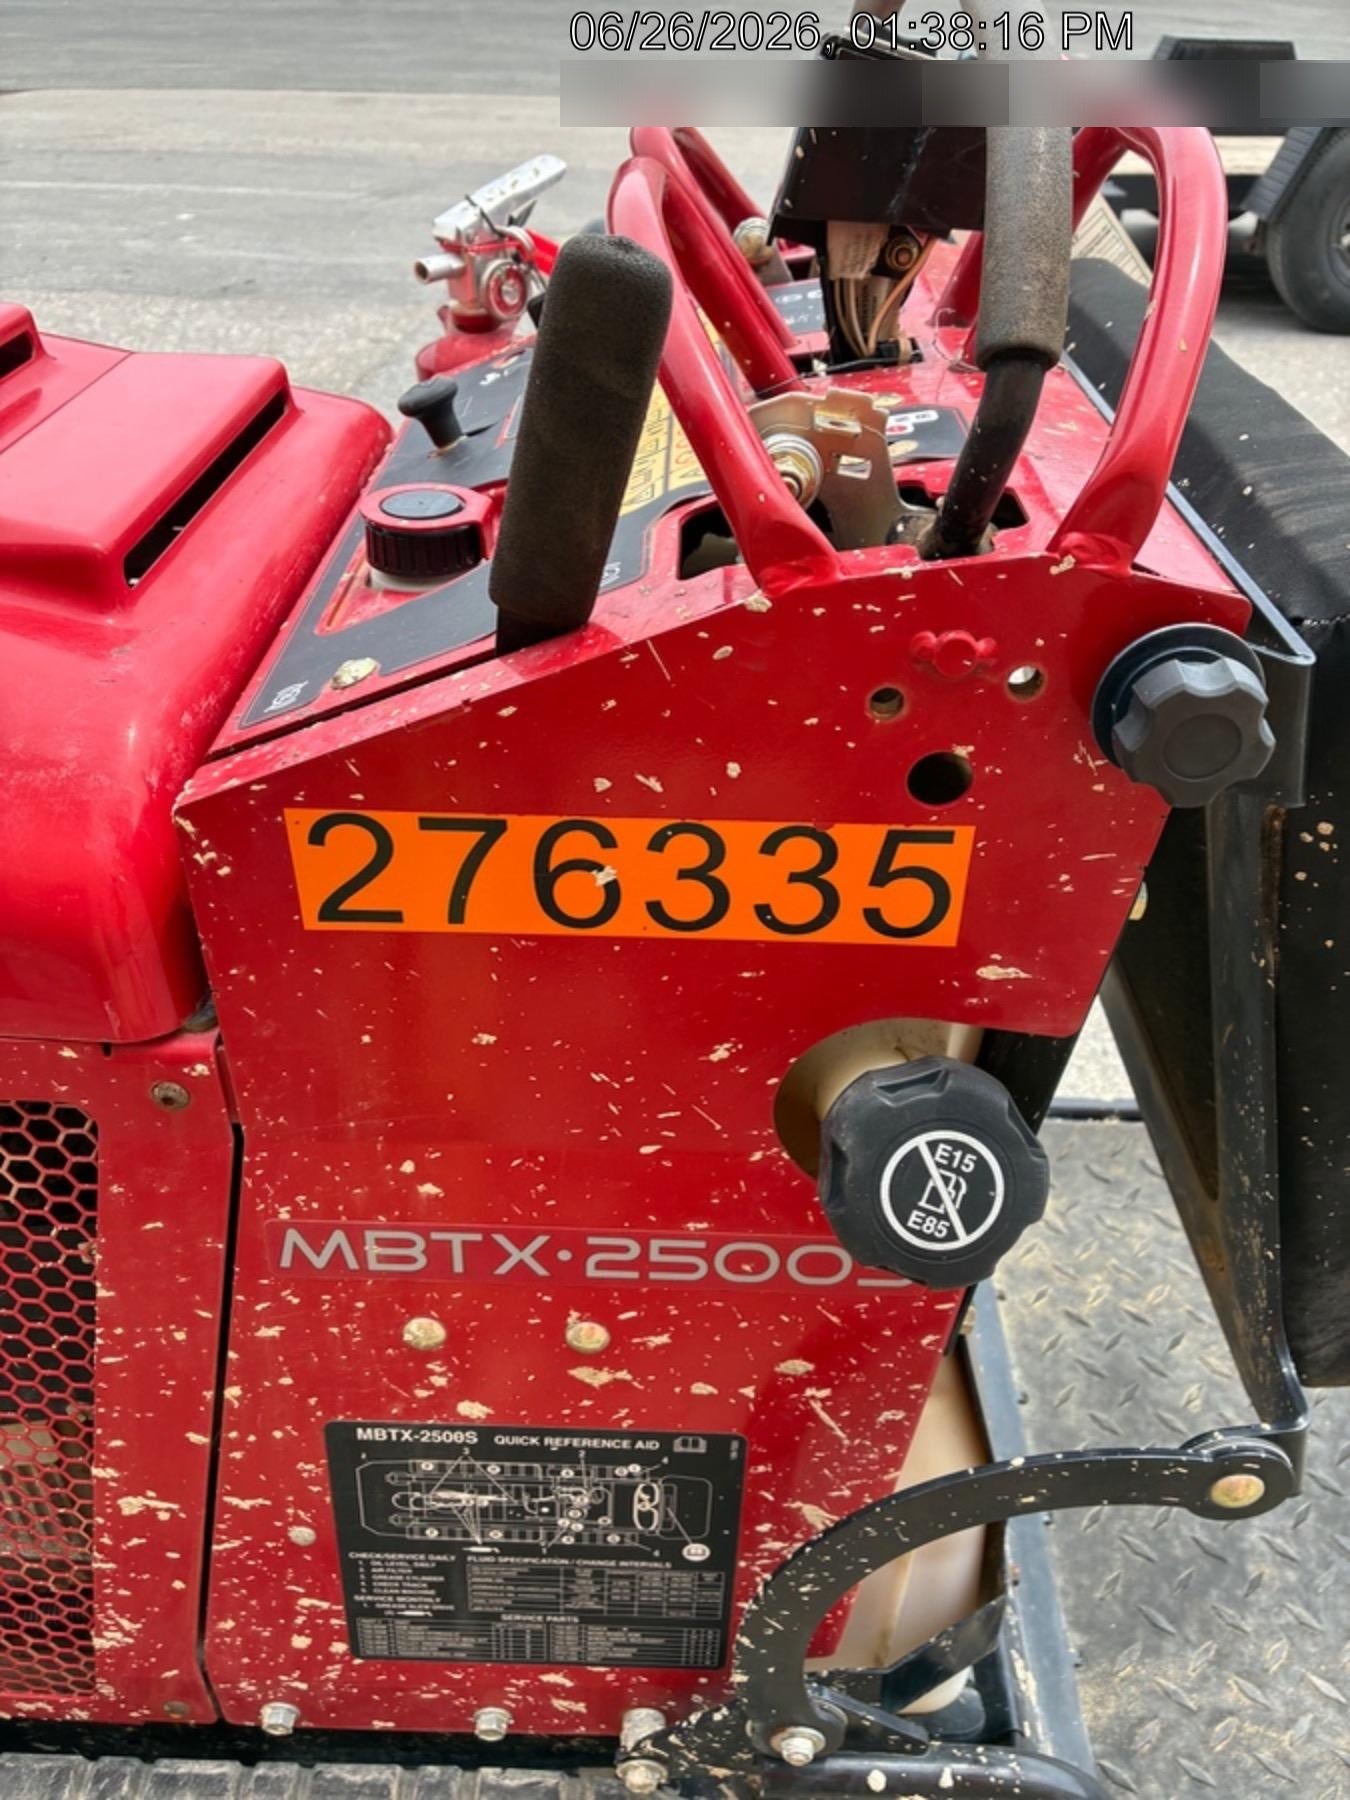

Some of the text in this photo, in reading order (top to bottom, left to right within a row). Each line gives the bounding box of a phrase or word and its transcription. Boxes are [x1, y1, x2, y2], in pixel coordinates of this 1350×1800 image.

[307, 812, 955, 939] 276335
[934, 1143, 978, 1173] E15
[906, 1209, 950, 1239] E85
[356, 1427, 661, 1450] MBTX-2500S QUICK REFERENCE AID
